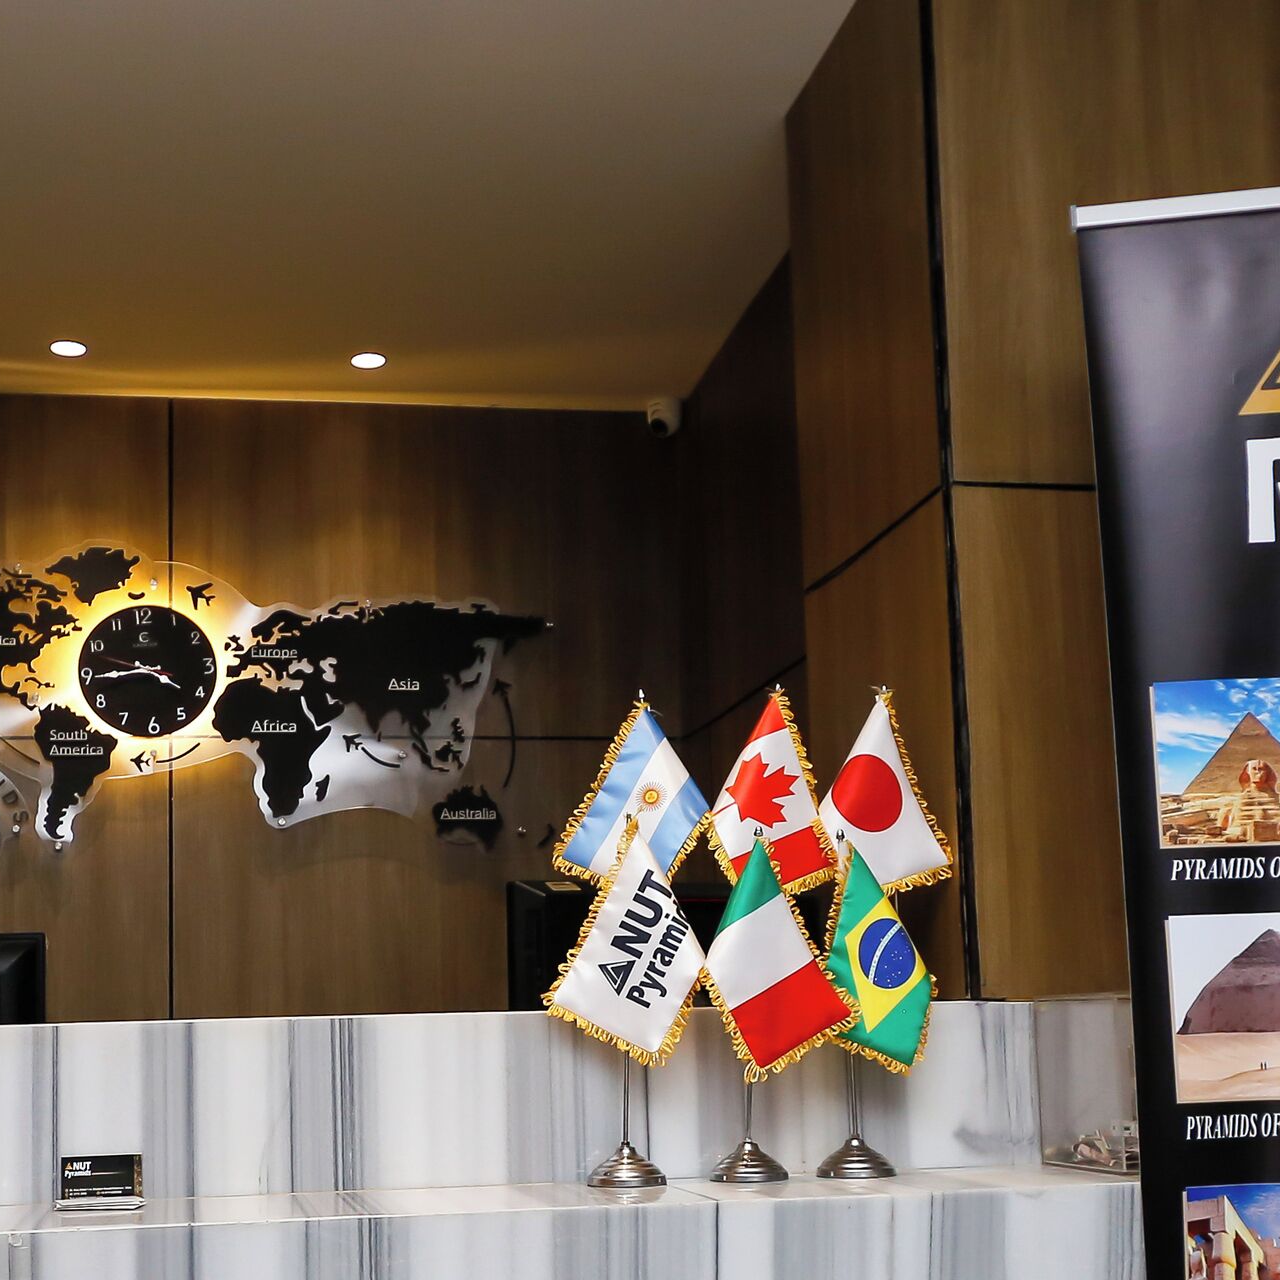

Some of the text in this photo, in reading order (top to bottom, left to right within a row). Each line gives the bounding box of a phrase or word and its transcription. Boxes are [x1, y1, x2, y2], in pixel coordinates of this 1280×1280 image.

[134, 608, 152, 625] 12
[111, 618, 122, 631] 11
[191, 631, 201, 645] 2
[89, 640, 104, 652] 10
[251, 646, 298, 659] Europe
[203, 657, 215, 675] 3
[81, 667, 93, 685] 9
[388, 678, 420, 691] Asia
[195, 686, 205, 698] 4
[96, 694, 106, 708] 8
[119, 712, 129, 725] 7
[177, 707, 186, 720] 5
[148, 716, 160, 734] 6
[251, 720, 297, 733] Africa
[49, 729, 88, 741] South
[49, 745, 104, 756] America
[440, 808, 497, 821] Australia
[1171, 857, 1265, 881] PYRAMIDS
[610, 869, 673, 960] NUT
[1186, 1114, 1259, 1140] PYRAMIDS
[73, 1161, 91, 1170] NUT
